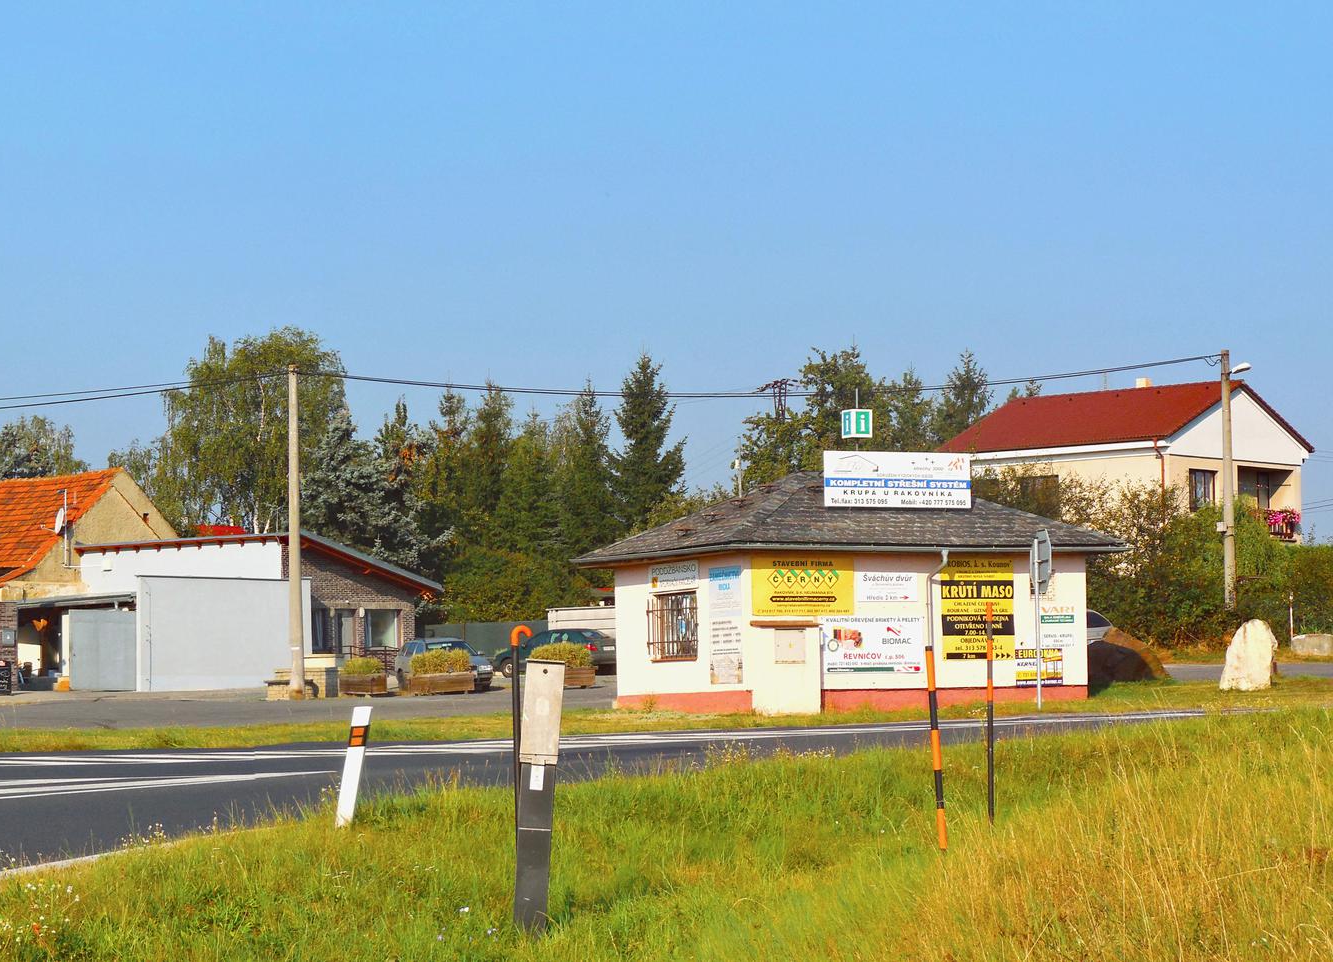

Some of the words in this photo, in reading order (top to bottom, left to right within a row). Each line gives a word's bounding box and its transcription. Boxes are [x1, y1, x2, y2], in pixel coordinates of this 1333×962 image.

[830, 477, 884, 487] KOMPLETNÍ
[887, 479, 927, 489] STŘEŠNÍ
[929, 480, 967, 489] SYSTÉM
[894, 489, 953, 497] RAKOVNÍKA
[772, 574, 833, 583] ČERNÝ
[942, 582, 977, 598] KRŮTÍ
[981, 585, 1013, 598] MASO
[843, 652, 882, 660] ŘEVNIČOV
